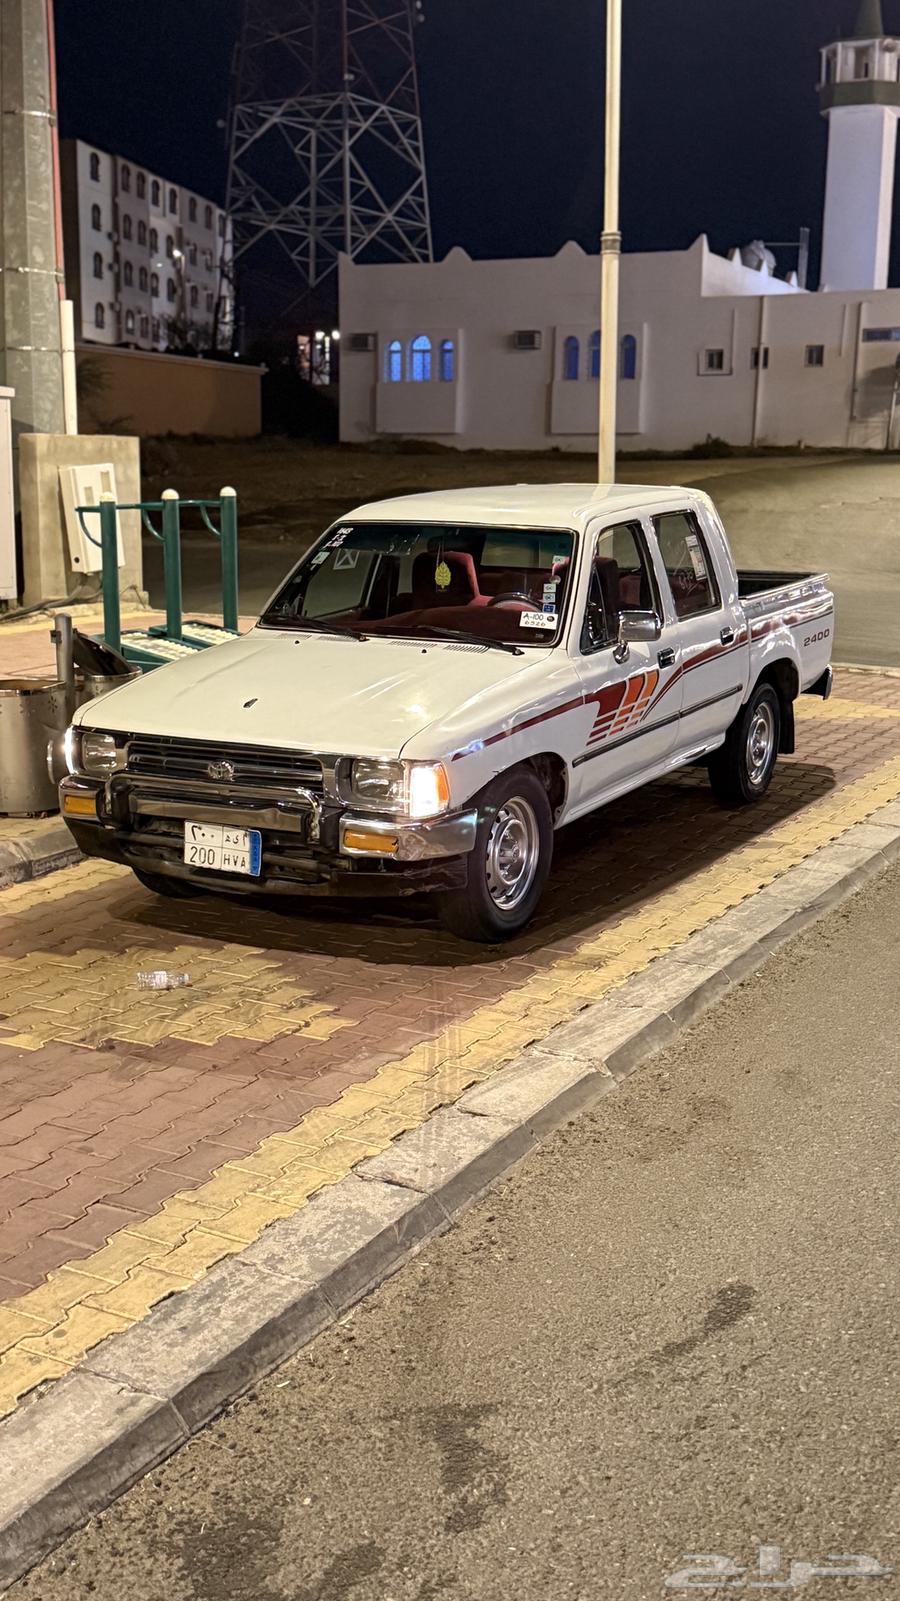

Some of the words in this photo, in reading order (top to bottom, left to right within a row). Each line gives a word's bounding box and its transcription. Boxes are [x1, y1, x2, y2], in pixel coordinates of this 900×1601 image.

[803, 628, 830, 647] 2400
[190, 846, 216, 866] 200
[223, 853, 246, 868] HVA
